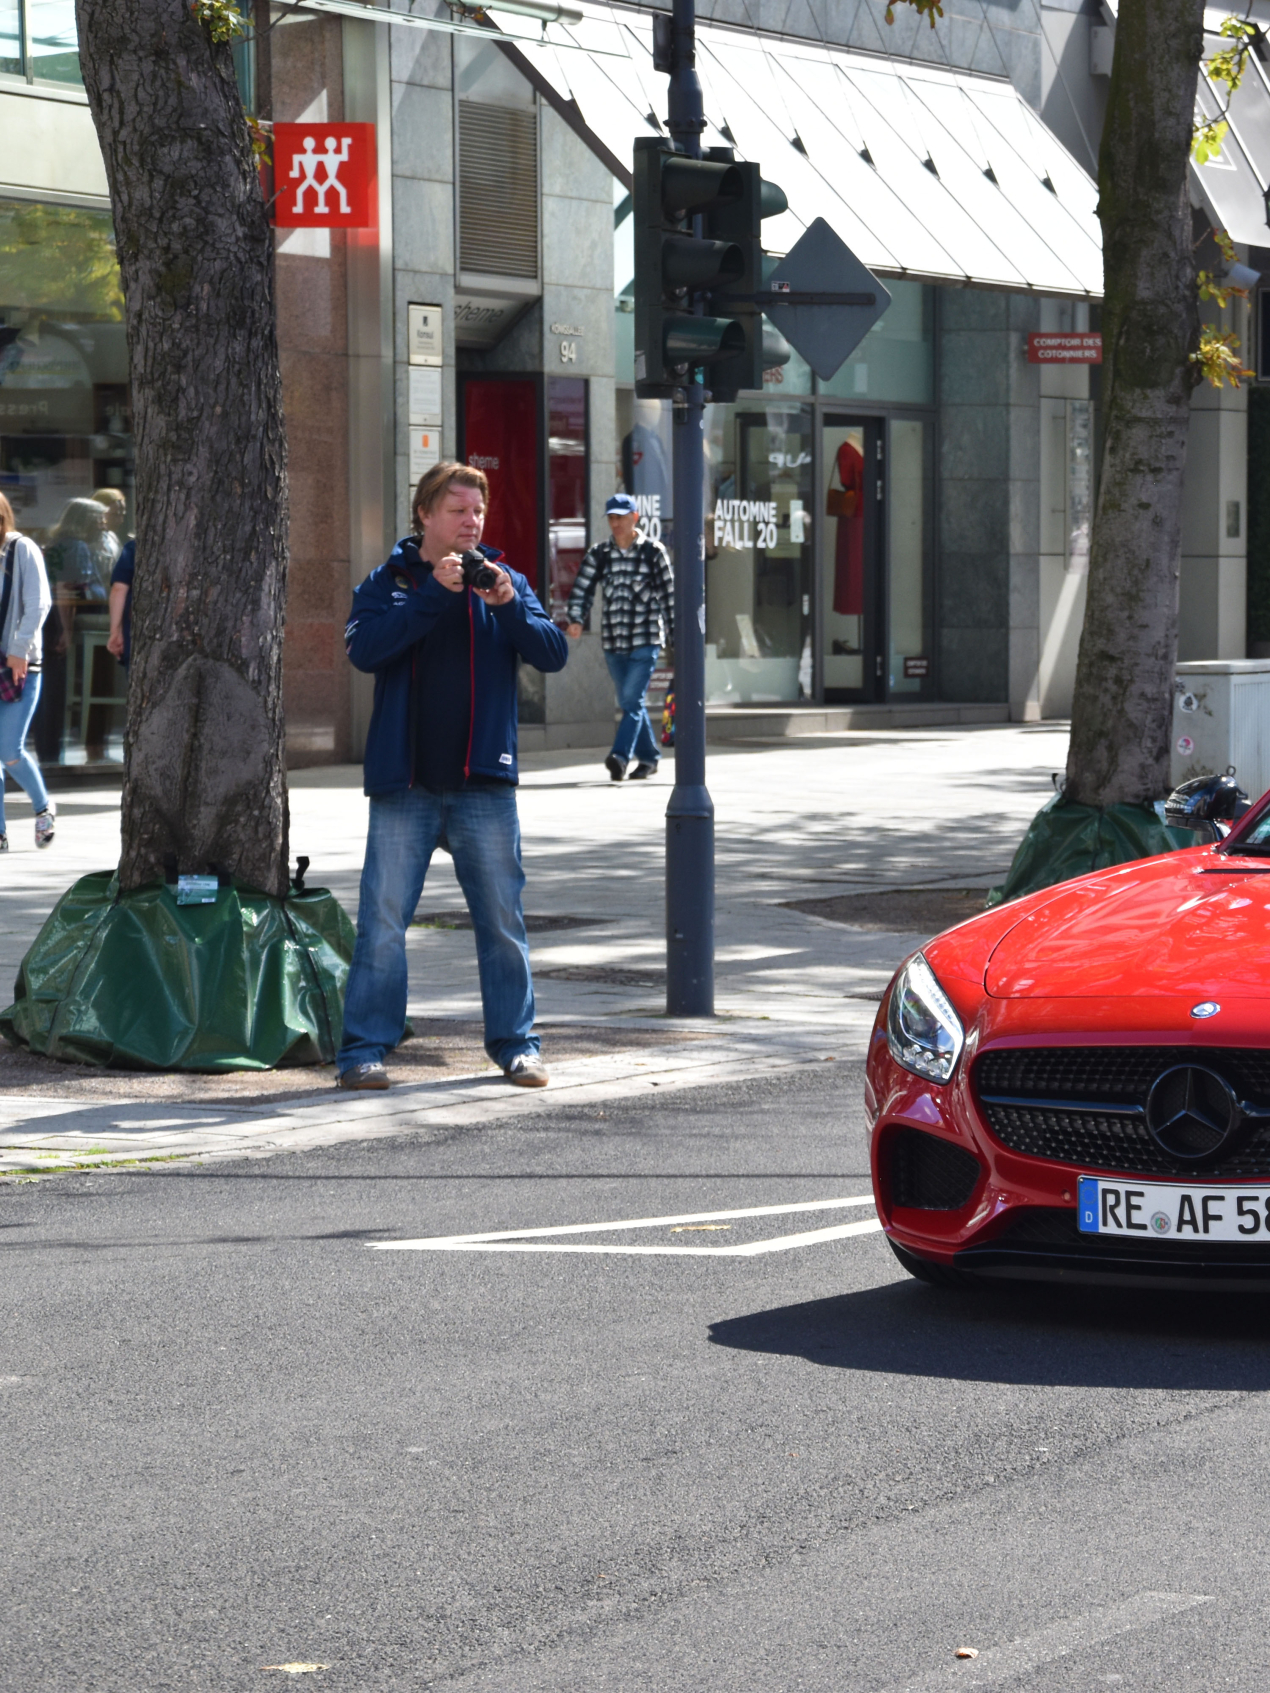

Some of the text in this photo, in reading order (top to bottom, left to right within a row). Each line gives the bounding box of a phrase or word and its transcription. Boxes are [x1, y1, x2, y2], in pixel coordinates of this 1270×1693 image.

[560, 341, 577, 363] 94
[1033, 337, 1102, 347] COMPTOIR DES
[1038, 349, 1098, 359] COTONNIERS
[468, 453, 500, 470] sheme
[714, 498, 778, 523] AUTOMNE
[714, 521, 778, 549] FALL 20
[1085, 1211, 1093, 1223] D
[1101, 1187, 1148, 1231] RE
[1176, 1194, 1226, 1234] AF
